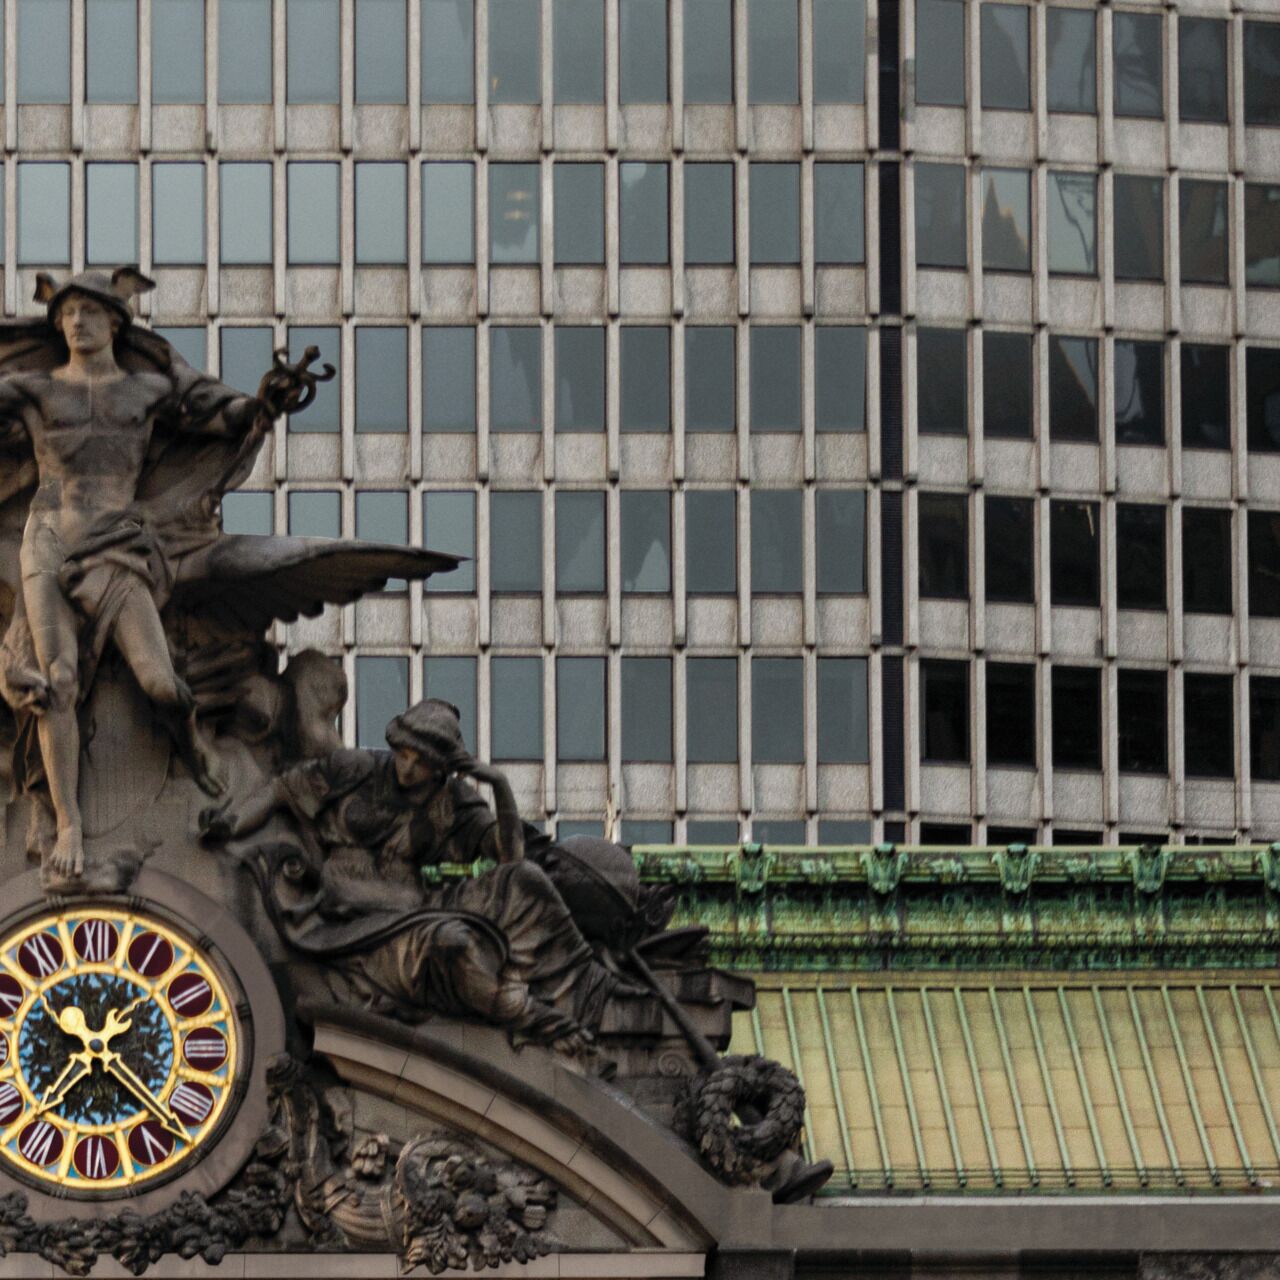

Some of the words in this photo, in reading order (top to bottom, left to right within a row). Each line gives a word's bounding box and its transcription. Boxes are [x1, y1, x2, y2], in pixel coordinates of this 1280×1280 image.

[24, 934, 59, 977] XI
[83, 920, 110, 962] XII
[137, 935, 162, 974] I
[170, 980, 210, 1010] II
[184, 1039, 226, 1058] III
[21, 1122, 56, 1165] VII
[86, 1138, 107, 1178] VI
[140, 1125, 169, 1165] V
